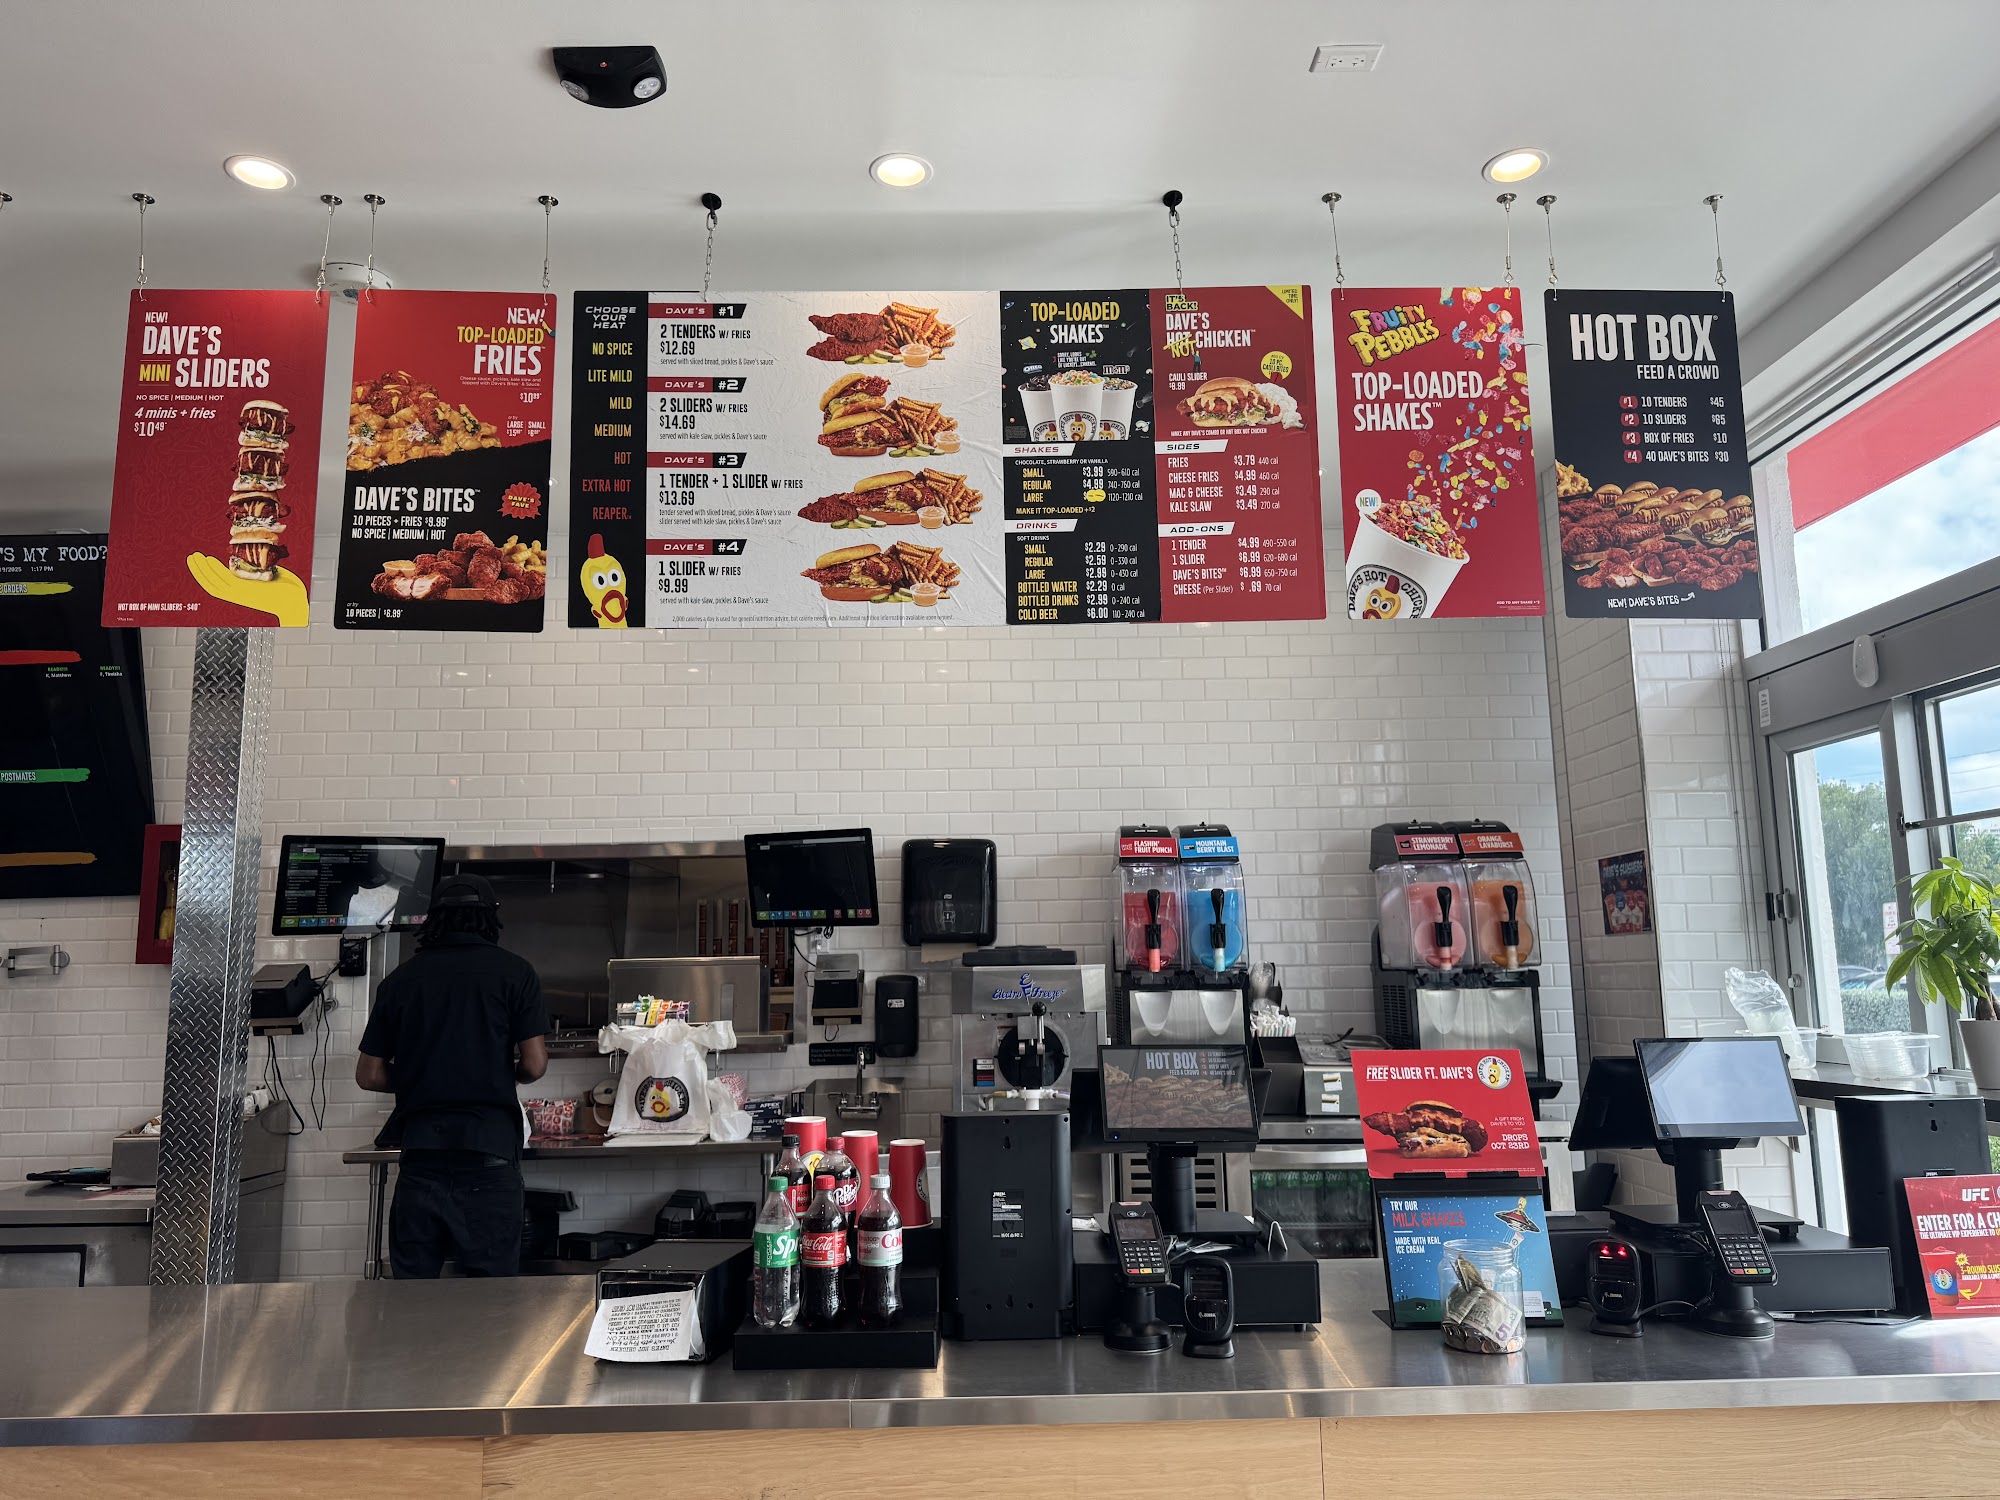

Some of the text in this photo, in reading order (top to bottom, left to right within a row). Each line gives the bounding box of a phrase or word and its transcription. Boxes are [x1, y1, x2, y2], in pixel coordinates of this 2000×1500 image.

[718, 306, 734, 317] #1
[1030, 302, 1120, 321] TOP-LOADED
[1166, 302, 1197, 310] BACK!
[145, 312, 168, 323] NEW!
[507, 308, 545, 324] NEW!
[1166, 312, 1210, 331] DAVE'S
[458, 326, 544, 344] TOP-LOADED
[660, 324, 751, 339] 2 TENDERS W/ FRIES
[1569, 313, 1637, 361] HOT
[143, 326, 222, 355] DAVE'S
[592, 343, 632, 355] NO SPICE
[660, 341, 695, 355] $12.69
[139, 358, 270, 388] MINI SLIDERS
[588, 370, 632, 382] LITE MILD
[1637, 364, 1720, 380] FEED A CROWD
[718, 380, 739, 391] #2
[1352, 371, 1483, 400] TOP-LOADED
[610, 397, 632, 410] MILD
[660, 398, 748, 412] 2 SLIDERS W/ FRIES
[1641, 396, 1688, 408] 10 TENDERS
[145, 408, 216, 418] minis fries
[660, 415, 695, 429] $14.69
[1643, 414, 1687, 425] 10 SLIDERS
[594, 424, 632, 436] MEDIUM
[1644, 432, 1694, 444] BOX OF FRIES
[614, 452, 631, 464] HOT
[718, 455, 738, 465] #3
[1646, 450, 1709, 462] 40 DAVE'S BITES
[1168, 457, 1188, 468] FRIES
[1023, 468, 1044, 478] SMALL
[1168, 471, 1219, 483] CHEESE FRIES
[582, 479, 631, 492] EXTRA HOT
[659, 474, 666, 488] 1
[670, 474, 709, 488] TENDER
[722, 474, 728, 488] 1
[732, 474, 768, 488] SLIDER
[771, 480, 781, 488] W/
[784, 480, 803, 489] FRIES
[1023, 480, 1051, 490] REGULAR
[1024, 493, 1043, 503] LARGE
[1169, 486, 1223, 498] MAC & CHEESE
[354, 486, 418, 512] DAVE'S
[659, 491, 695, 506] $13.69
[1170, 501, 1212, 512] KALE SLAW
[352, 528, 446, 540] NO SPICE MEDIUM HOT
[718, 541, 739, 552] #4
[23, 546, 107, 562] MY FOOD?
[659, 561, 741, 576] 1 SLIDER W/ FRIES
[4, 584, 27, 593] ORDERS
[659, 578, 688, 593] $9.99
[1018, 581, 1078, 593] BOTTLED WATER
[1018, 594, 1079, 607] BOTTLED DRINKS
[1628, 595, 1680, 608] DAVE'S BITES
[1018, 608, 1058, 620] COLD BEER
[0, 772, 36, 782] POSTMATES
[992, 989, 1022, 1000] Electro
[1146, 1052, 1198, 1070] HOT BOX
[1366, 1067, 1473, 1080] FREE SLIDER FT. DAVE'S
[844, 1183, 854, 1193] Dr
[1962, 1187, 1990, 1202] UFC
[1390, 1201, 1418, 1211] TRY OUR
[1392, 1212, 1466, 1228] MILK SHAKES
[1917, 1213, 1986, 1231] ENTER FOR A
[1952, 1230, 1960, 1238] VIP
[1395, 1236, 1441, 1245] MADE WITH REAL
[1396, 1245, 1425, 1254] ICE CREAM
